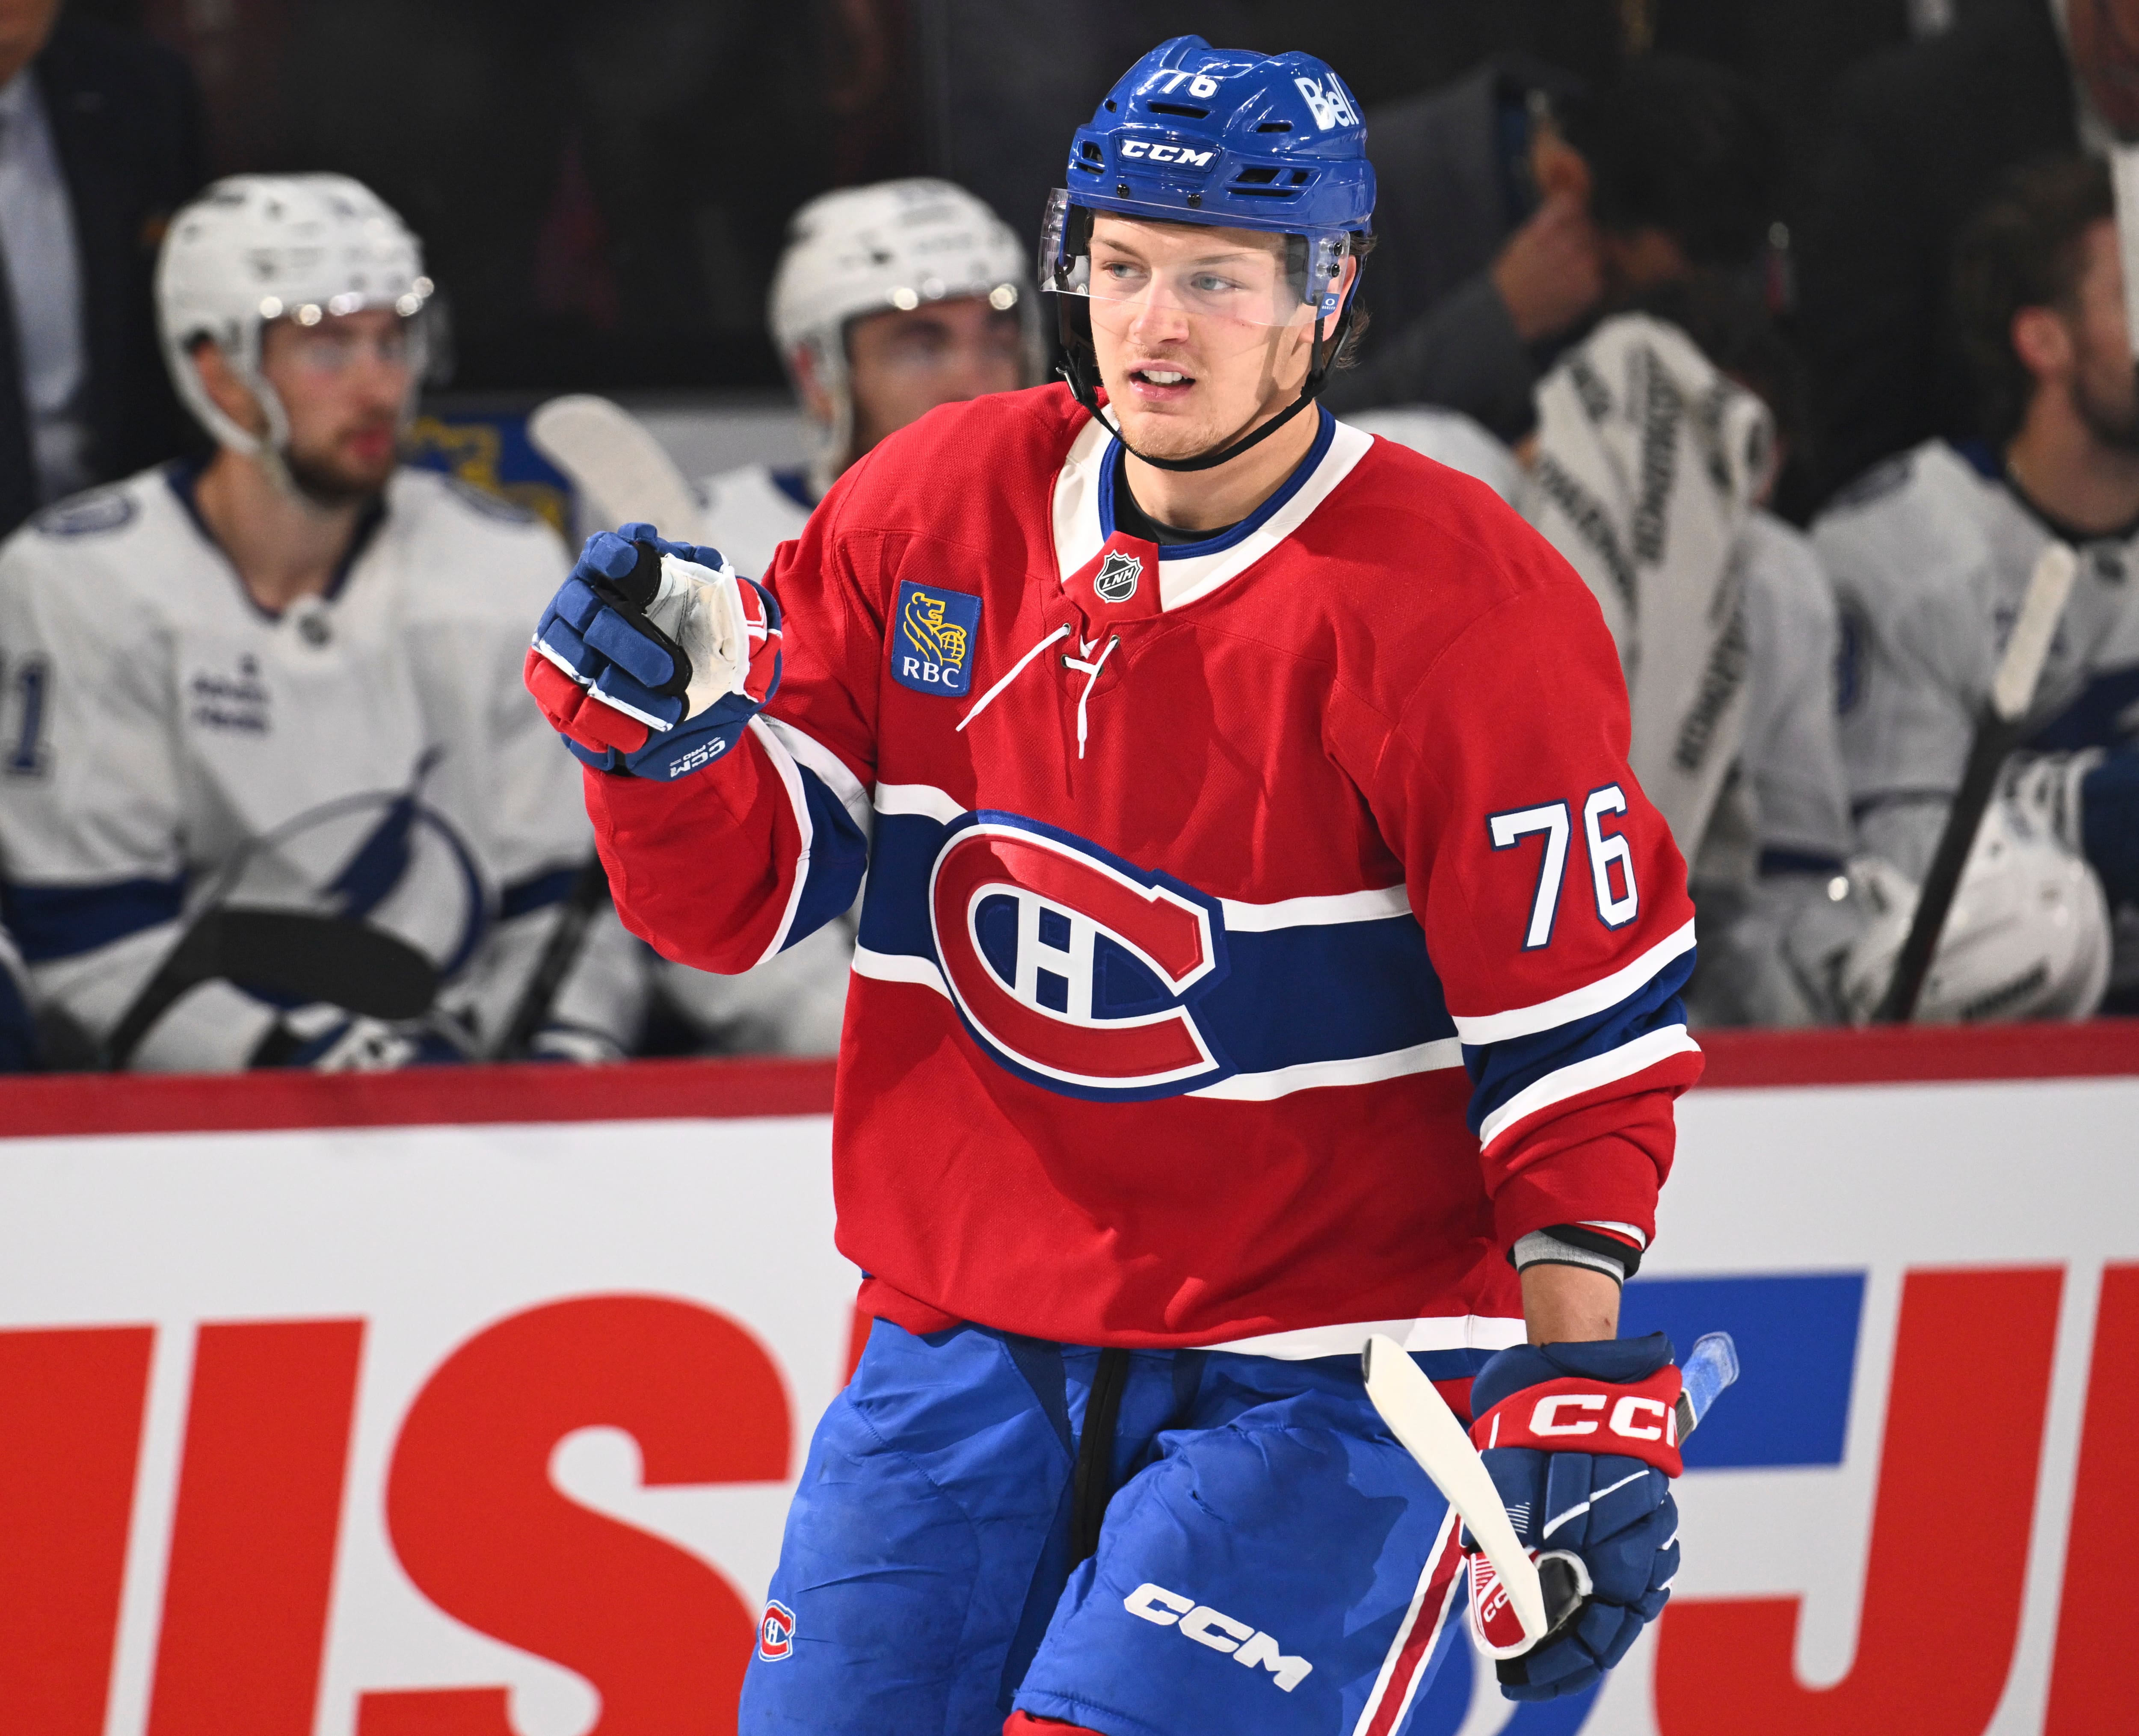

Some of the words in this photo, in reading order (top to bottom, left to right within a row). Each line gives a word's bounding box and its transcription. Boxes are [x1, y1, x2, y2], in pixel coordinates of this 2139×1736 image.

[1294, 73, 1360, 130] Bell
[1121, 139, 1214, 167] CCM
[1102, 567, 1135, 589] LNH
[903, 657, 960, 688] RBC
[670, 740, 726, 778] CCM
[1486, 781, 1639, 953] 76
[1483, 1587, 1510, 1623] CC
[1123, 1582, 1313, 1693] CCM
